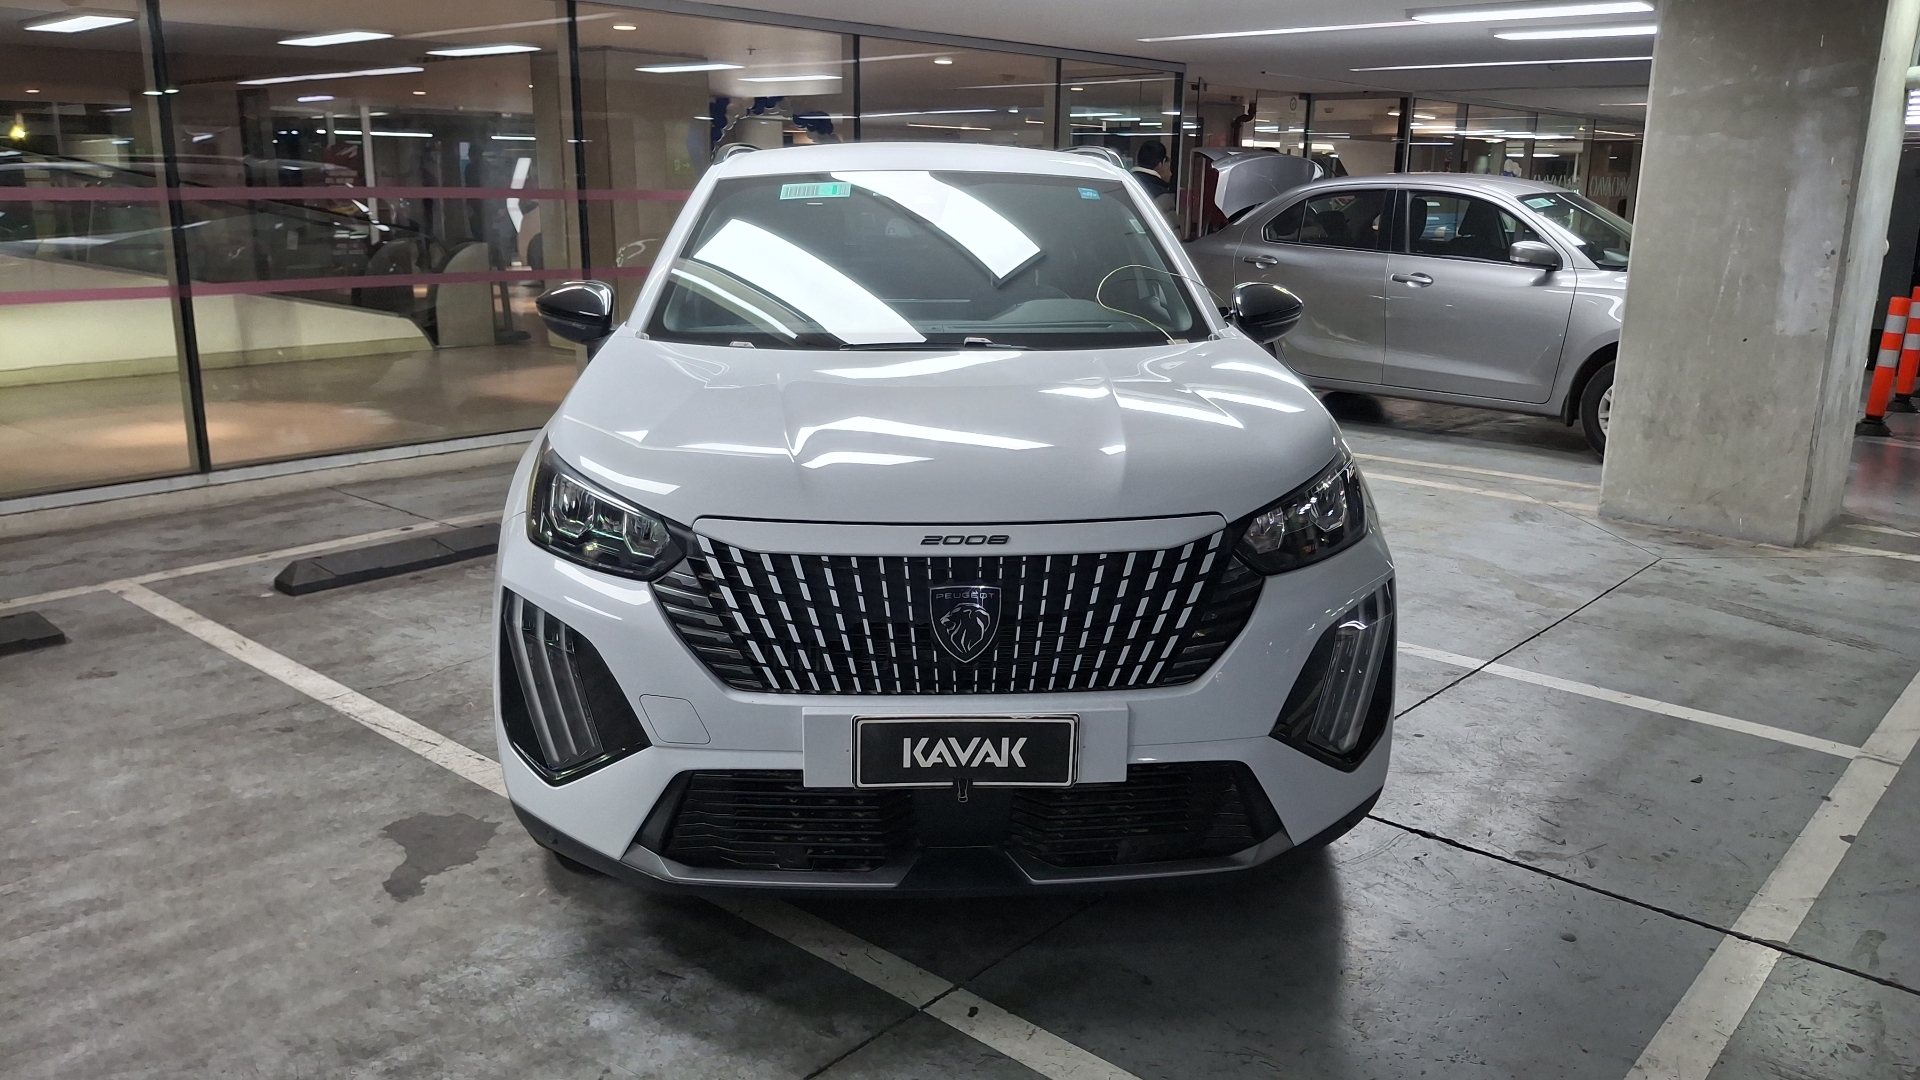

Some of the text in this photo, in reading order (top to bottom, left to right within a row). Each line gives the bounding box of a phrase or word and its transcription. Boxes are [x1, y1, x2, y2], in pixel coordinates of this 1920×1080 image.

[920, 535, 1010, 545] 2008
[935, 592, 995, 600] PEUGEOT
[903, 737, 1028, 768] KAVAK
